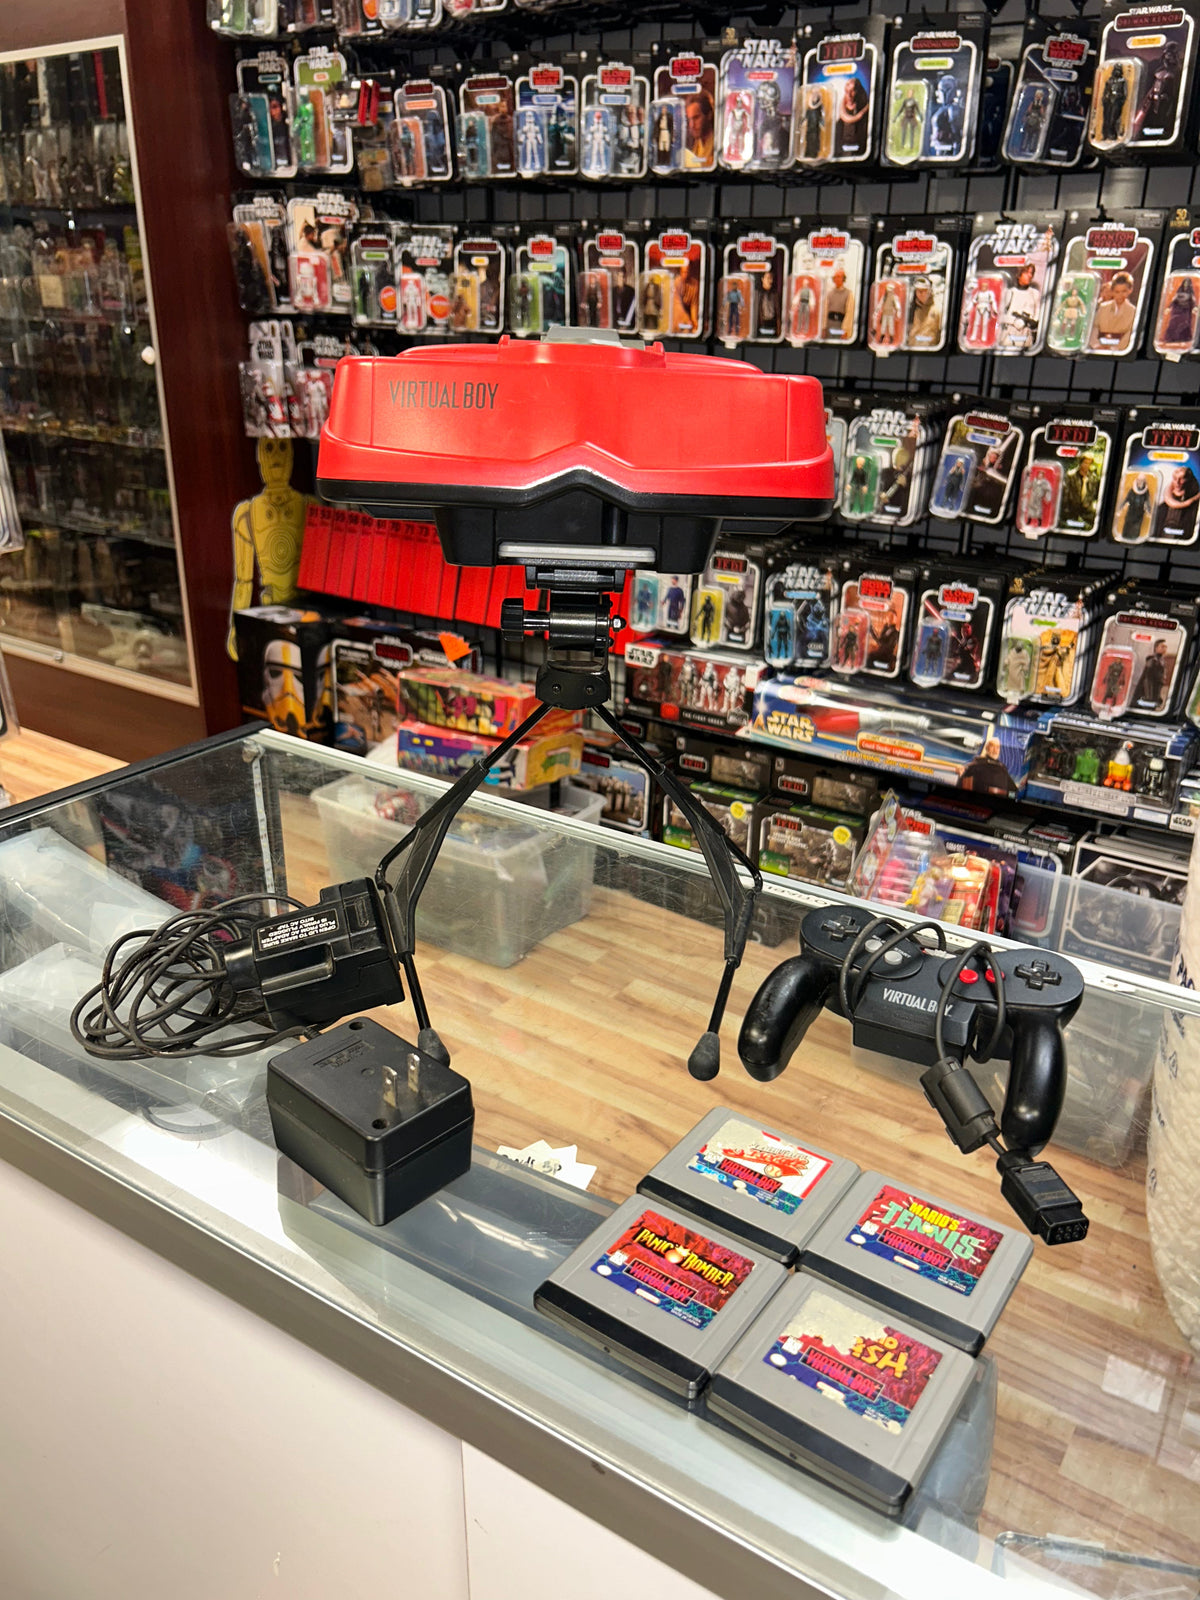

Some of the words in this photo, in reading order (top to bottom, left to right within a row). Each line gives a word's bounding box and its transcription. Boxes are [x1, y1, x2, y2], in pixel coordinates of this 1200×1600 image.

[743, 39, 782, 53] STAR
[742, 54, 784, 69] WARS
[995, 224, 1037, 238] STAR
[1102, 222, 1125, 230] STAR
[991, 238, 1041, 253] WARS
[1095, 248, 1122, 256] WARS
[389, 380, 460, 409] VIRTUAL
[463, 382, 499, 410] BOY
[870, 408, 908, 424] STAR
[1053, 418, 1072, 426] STAR
[1072, 419, 1094, 427] WARS
[870, 422, 909, 437] WARS
[1152, 422, 1172, 430] STAR
[1172, 423, 1196, 431] WARS
[1052, 428, 1090, 442] JEDI
[1150, 432, 1192, 446] JEDI
[785, 564, 820, 578] STAR
[783, 576, 826, 590] WARS
[1030, 591, 1069, 604] STAR
[1025, 604, 1069, 617] WARS
[628, 648, 654, 658] STAR
[628, 655, 654, 665] WARS
[767, 710, 814, 731] STAR
[767, 722, 814, 744] WARS
[683, 758, 704, 770] JEDI
[782, 780, 804, 792] JEDI
[777, 818, 799, 831] JEDI
[300, 925, 318, 933] FROM
[319, 920, 336, 928] PLUG
[261, 933, 290, 943] ADAPTER
[268, 926, 298, 937] PLUGGED
[894, 947, 912, 959] START
[882, 988, 928, 1012] VIRTUAL
[927, 998, 954, 1016] BY
[719, 1158, 756, 1185] VIRTUAL
[756, 1176, 782, 1194] BOY
[909, 1202, 960, 1232] MARIO'S
[880, 1201, 976, 1261] TENNIS
[882, 1230, 928, 1262] VIRTUAL
[924, 1250, 950, 1268] BOY
[634, 1228, 674, 1257] PANIC
[680, 1251, 735, 1289] BOMBER
[628, 1260, 672, 1297] VIRTUAL
[668, 1282, 694, 1303] BOY
[806, 1349, 853, 1387] VIRTUAL
[850, 1372, 880, 1400] BOY
